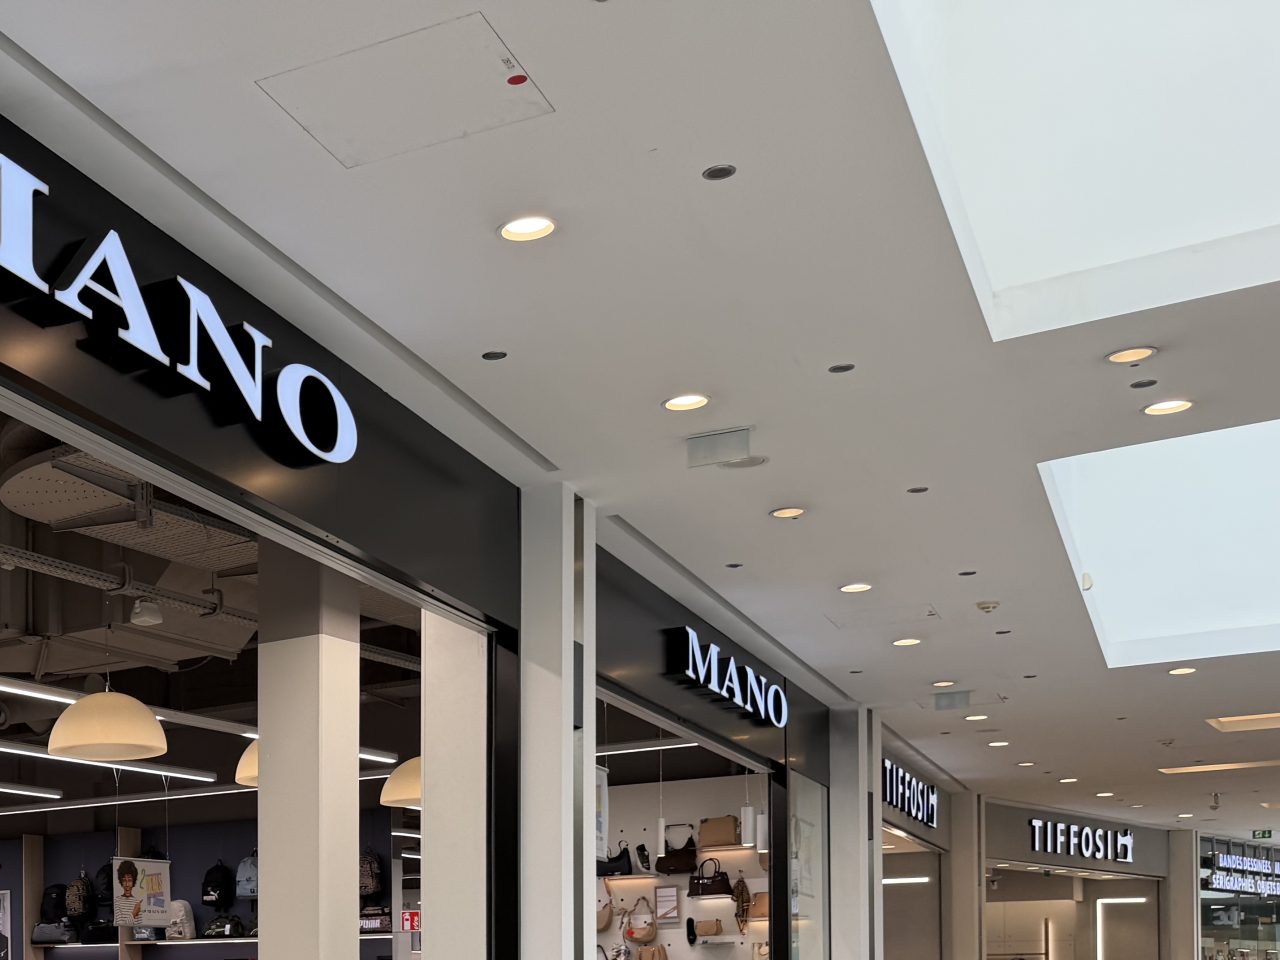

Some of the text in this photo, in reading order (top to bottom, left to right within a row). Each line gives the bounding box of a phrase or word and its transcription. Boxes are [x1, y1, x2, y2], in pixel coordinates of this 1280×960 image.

[686, 626, 788, 728] MANO
[884, 758, 927, 822] TIFFOSI
[1032, 819, 1112, 859] TIFFOSI
